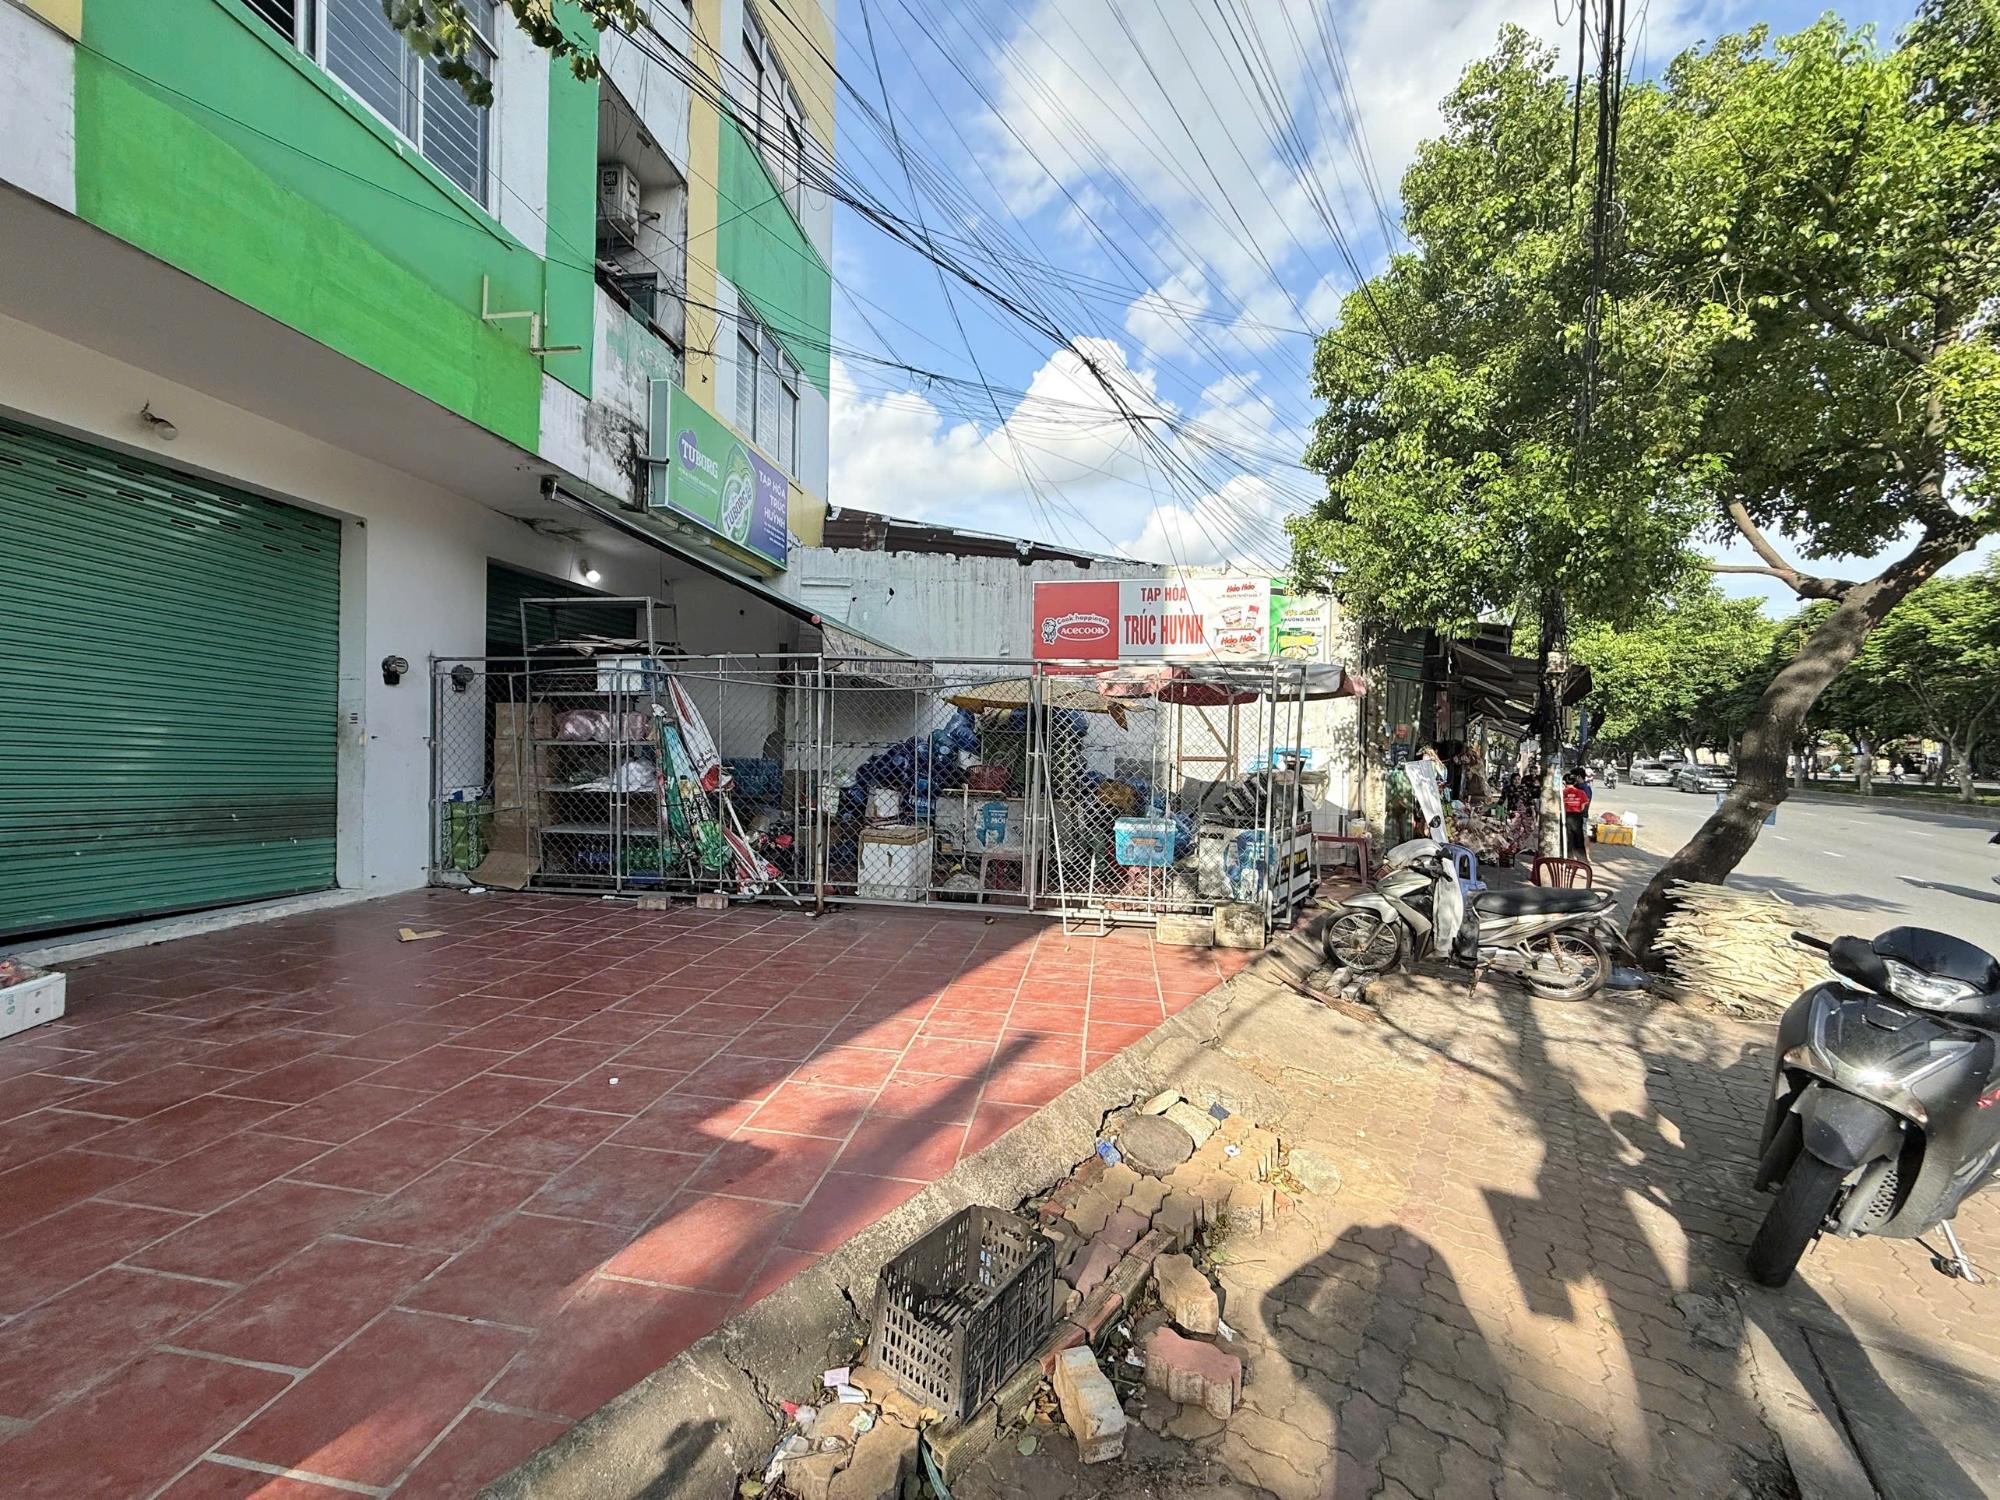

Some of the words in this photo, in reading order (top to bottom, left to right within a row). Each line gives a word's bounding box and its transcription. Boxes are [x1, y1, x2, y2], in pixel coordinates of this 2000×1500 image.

[681, 437, 718, 480] TUBORG
[1141, 588, 1161, 605] TẠP
[1164, 584, 1187, 601] HÓA
[1123, 608, 1156, 645] TRÚC
[1161, 608, 1204, 645] HUỲNH
